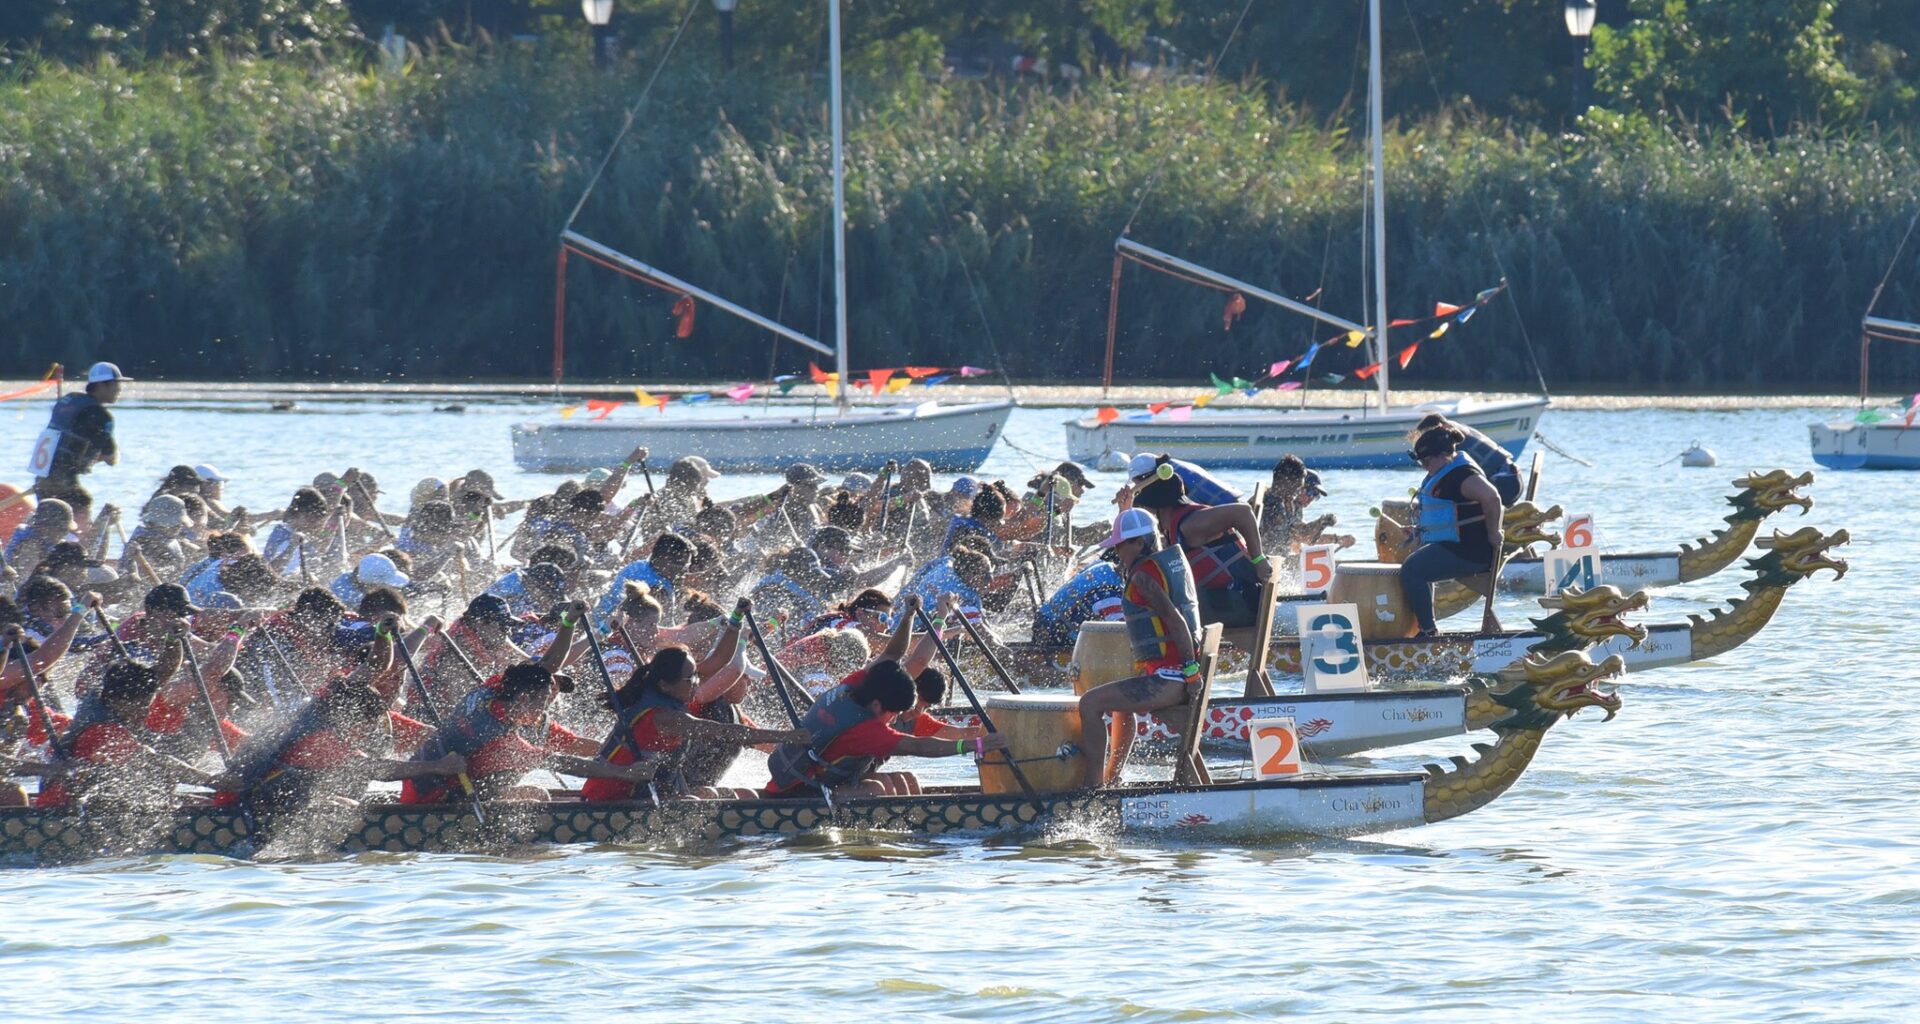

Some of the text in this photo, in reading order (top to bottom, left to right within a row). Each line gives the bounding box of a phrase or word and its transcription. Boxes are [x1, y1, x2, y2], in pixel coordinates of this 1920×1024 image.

[34, 436, 51, 470] 6
[1565, 517, 1592, 548] 6
[1305, 549, 1332, 589] 5
[1311, 613, 1359, 675] 3
[1257, 705, 1297, 714] HONG
[1256, 726, 1299, 775] 2
[1126, 800, 1169, 810] HONG
[1126, 810, 1170, 820] KONG
